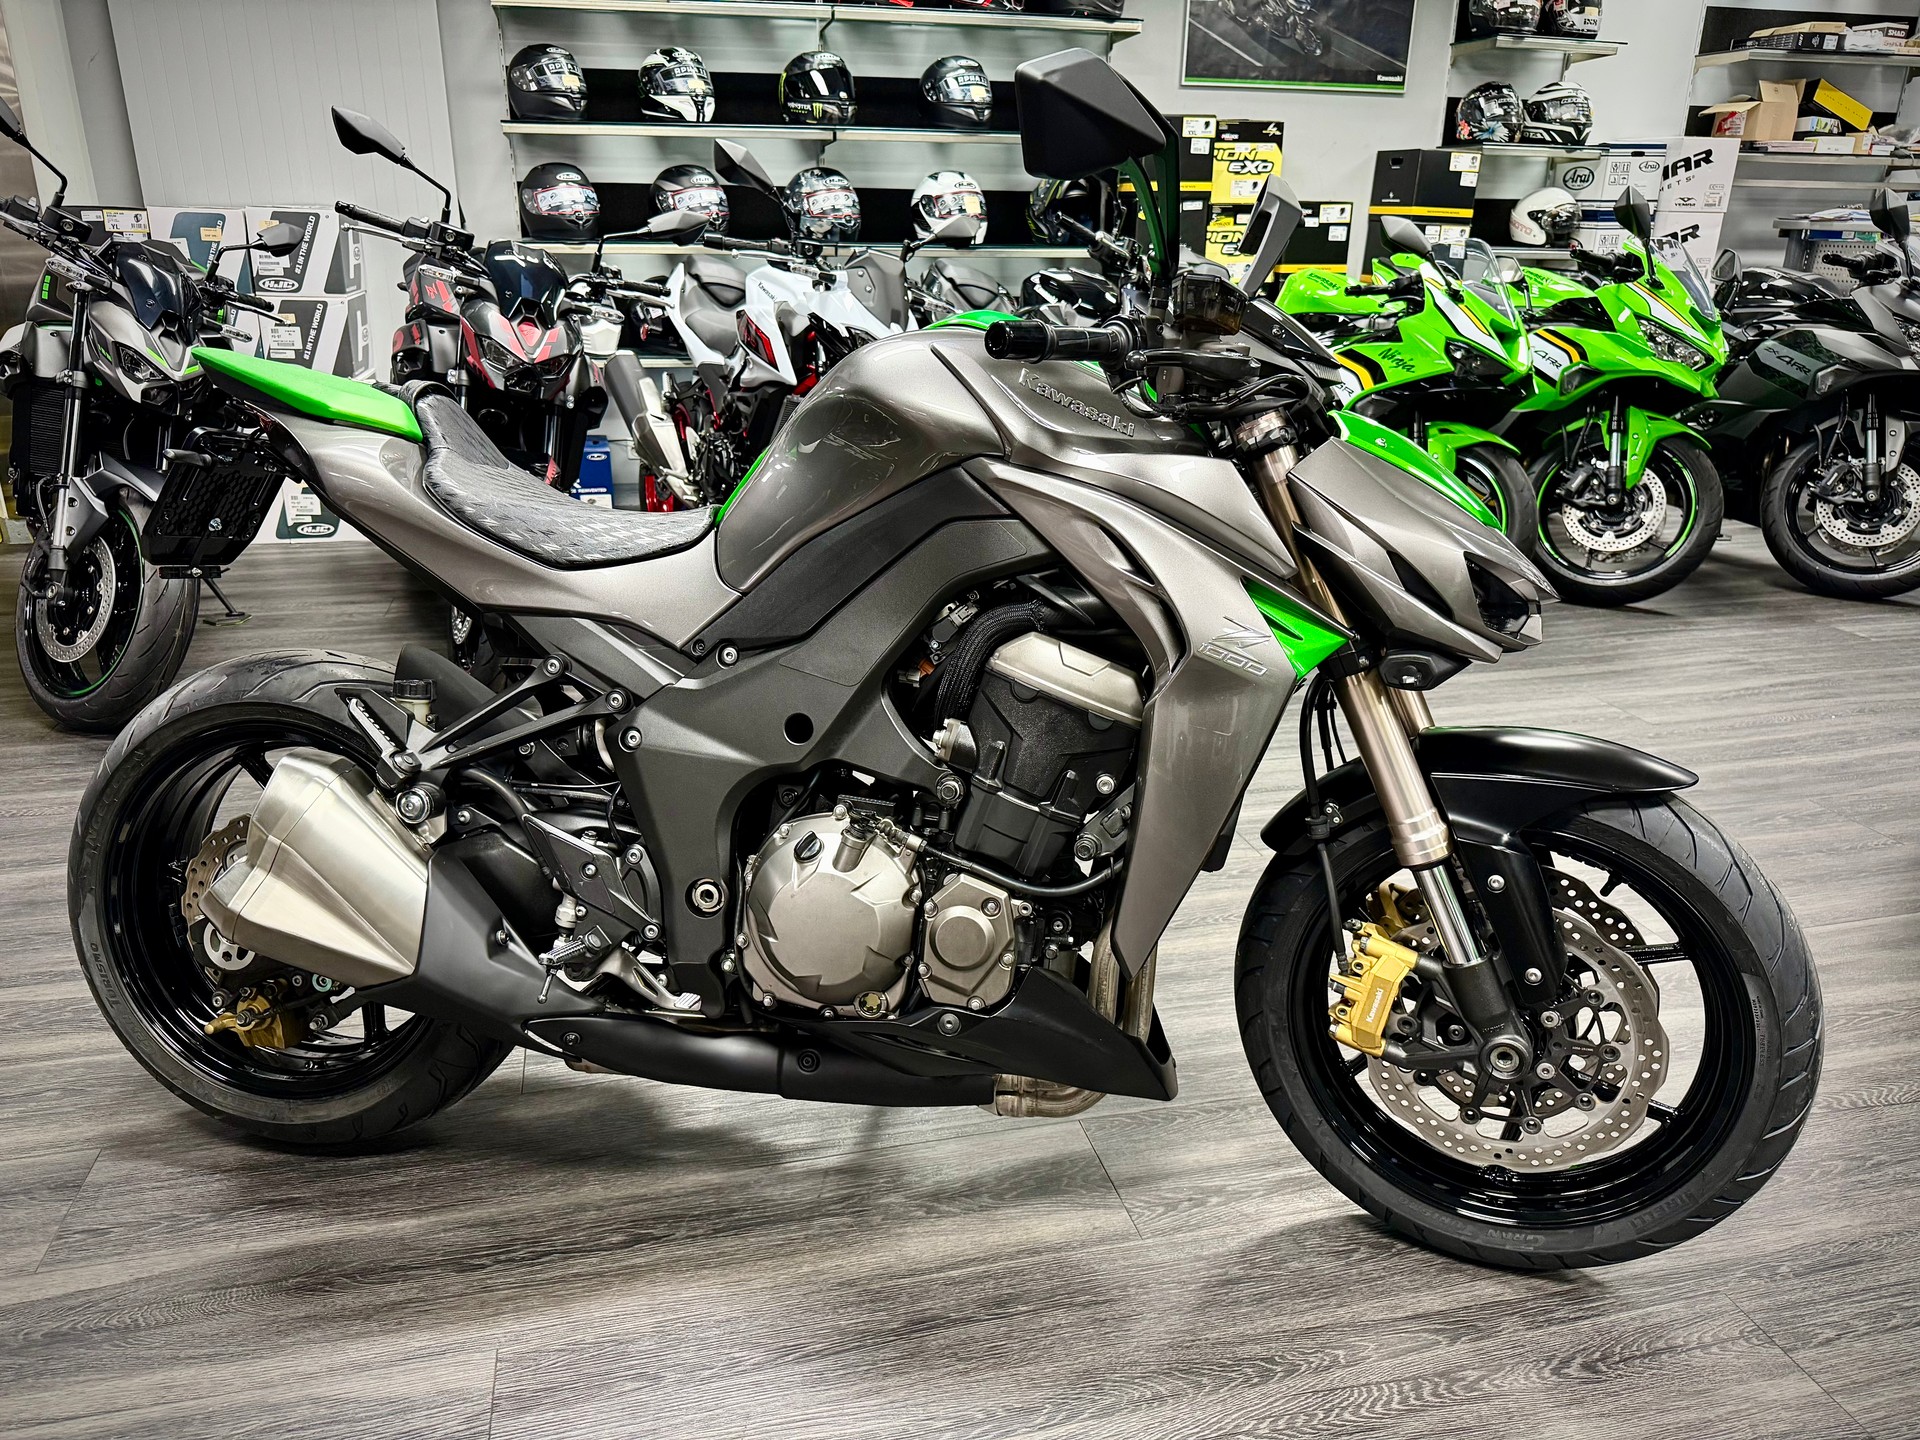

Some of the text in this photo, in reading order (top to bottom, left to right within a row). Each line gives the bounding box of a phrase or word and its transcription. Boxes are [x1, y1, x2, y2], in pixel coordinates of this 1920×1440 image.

[1228, 160, 1274, 174] EXO
[1564, 169, 1591, 184] Arai
[1641, 161, 1659, 171] Arai
[303, 215, 316, 242] WORLD
[299, 241, 309, 256] THE
[264, 280, 294, 289] HJC
[311, 303, 324, 329] WORLD
[308, 328, 317, 342] THE
[1378, 347, 1416, 374] Ninja
[1019, 367, 1135, 438] Kawasaki
[1197, 642, 1268, 677] 1000
[90, 941, 121, 1010] TURISMO
[1366, 987, 1384, 1023] Kawasaki
